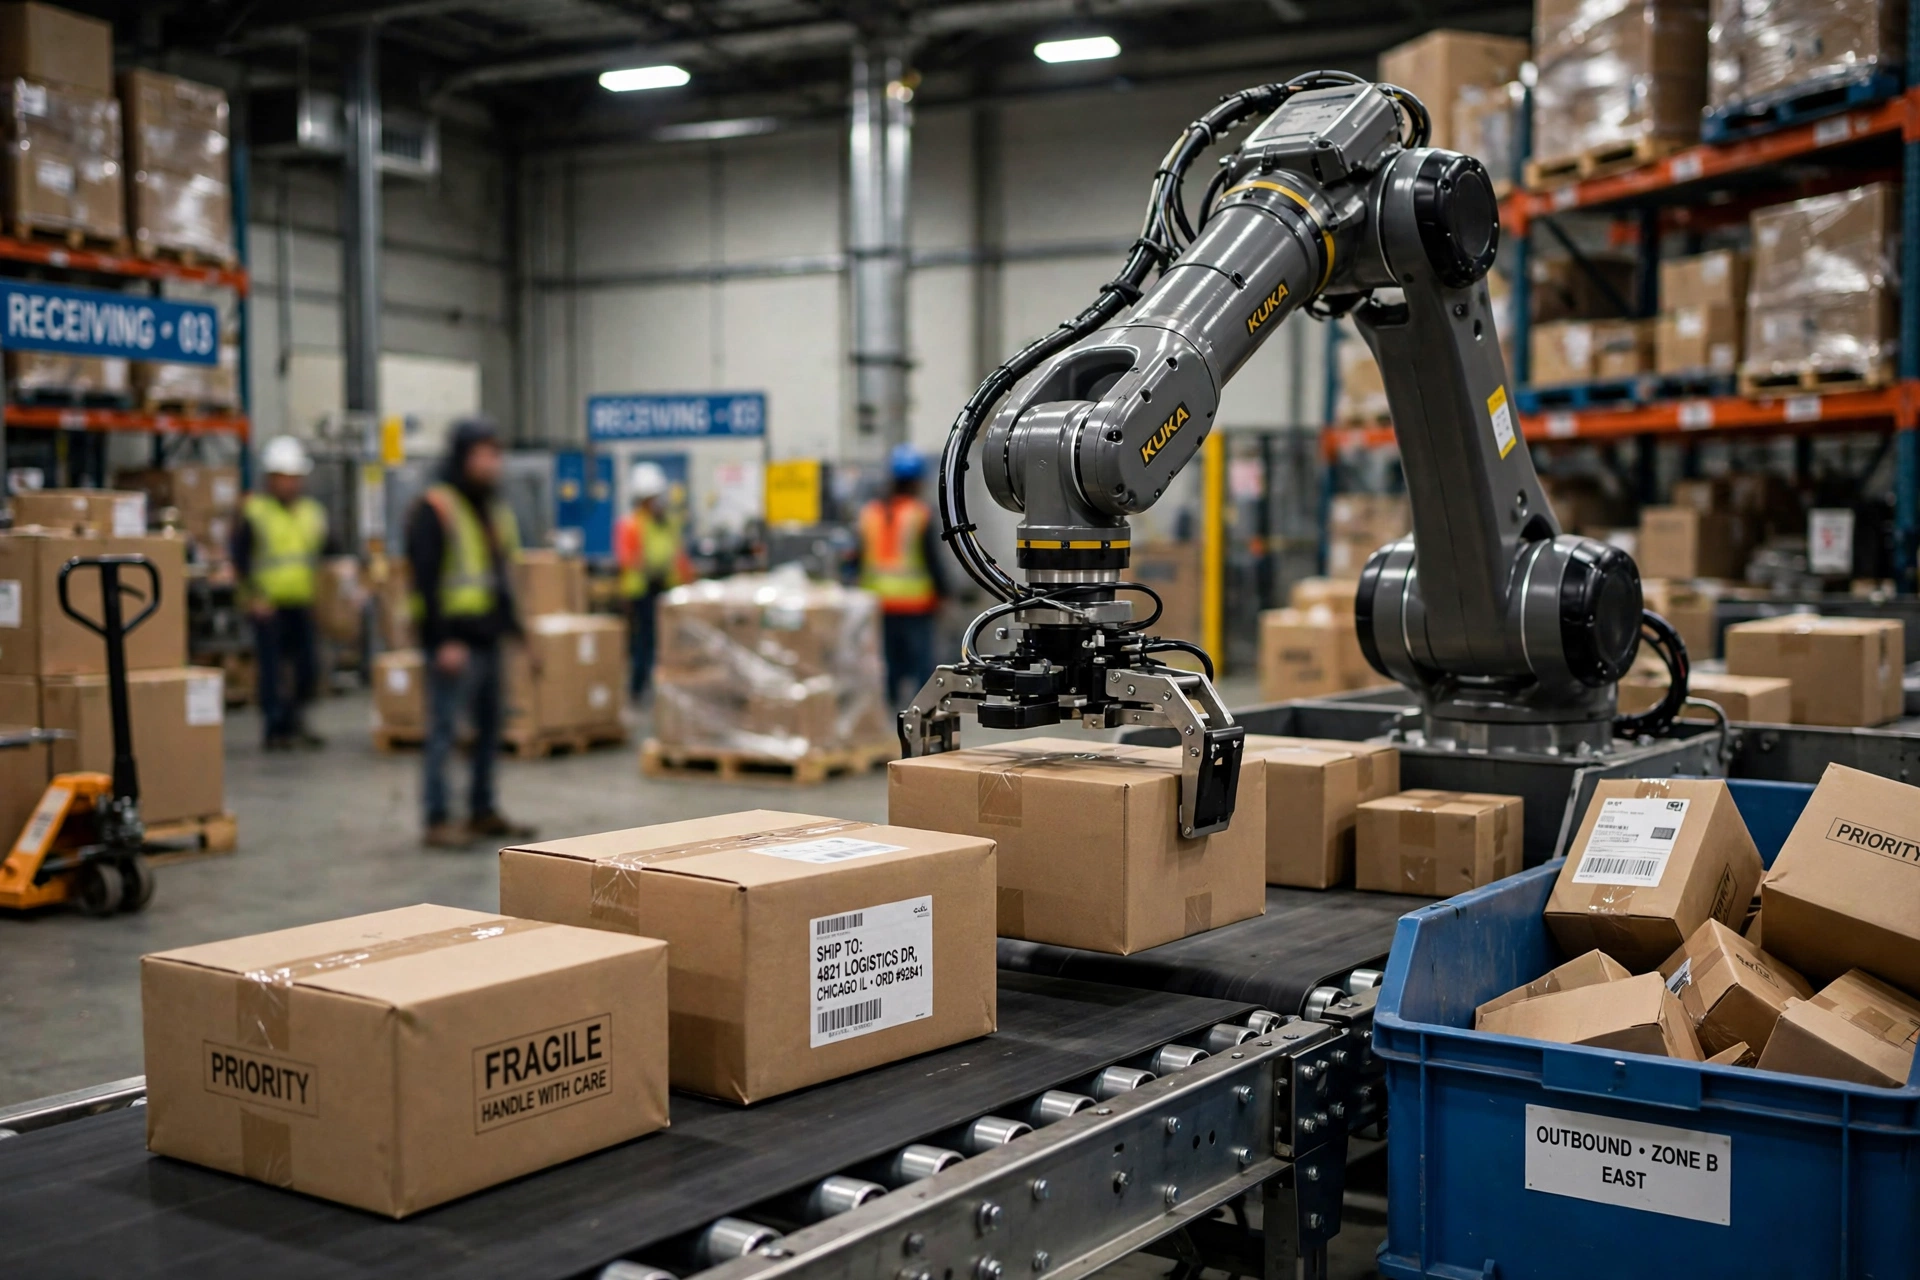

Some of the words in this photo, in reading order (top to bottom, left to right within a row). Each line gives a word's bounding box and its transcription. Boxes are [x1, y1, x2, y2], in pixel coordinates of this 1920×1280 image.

[7, 292, 155, 350] RECEIVING
[178, 311, 214, 355] 03
[1247, 283, 1289, 334] KUKA
[1141, 407, 1189, 463] KUKA
[1836, 823, 1920, 862] PRIORITY
[816, 942, 842, 962] SHIP
[844, 938, 863, 956] TO:
[817, 962, 841, 982] 4821
[844, 950, 898, 977] LOGISTICS
[901, 946, 918, 964] DR,
[816, 979, 857, 1002] CHICAGO
[859, 977, 868, 991] IL
[875, 970, 894, 987] ORD
[211, 1052, 309, 1104] PRIORITY
[485, 1023, 602, 1089] FRAGILE
[481, 1091, 535, 1123] HANDLE
[538, 1081, 571, 1111] WITH
[574, 1069, 607, 1096] CARE
[1536, 1126, 1632, 1157] OUTBOUND
[1651, 1144, 1700, 1169] ZONE
[1706, 1154, 1718, 1172] B
[1602, 1166, 1646, 1189] EAST
